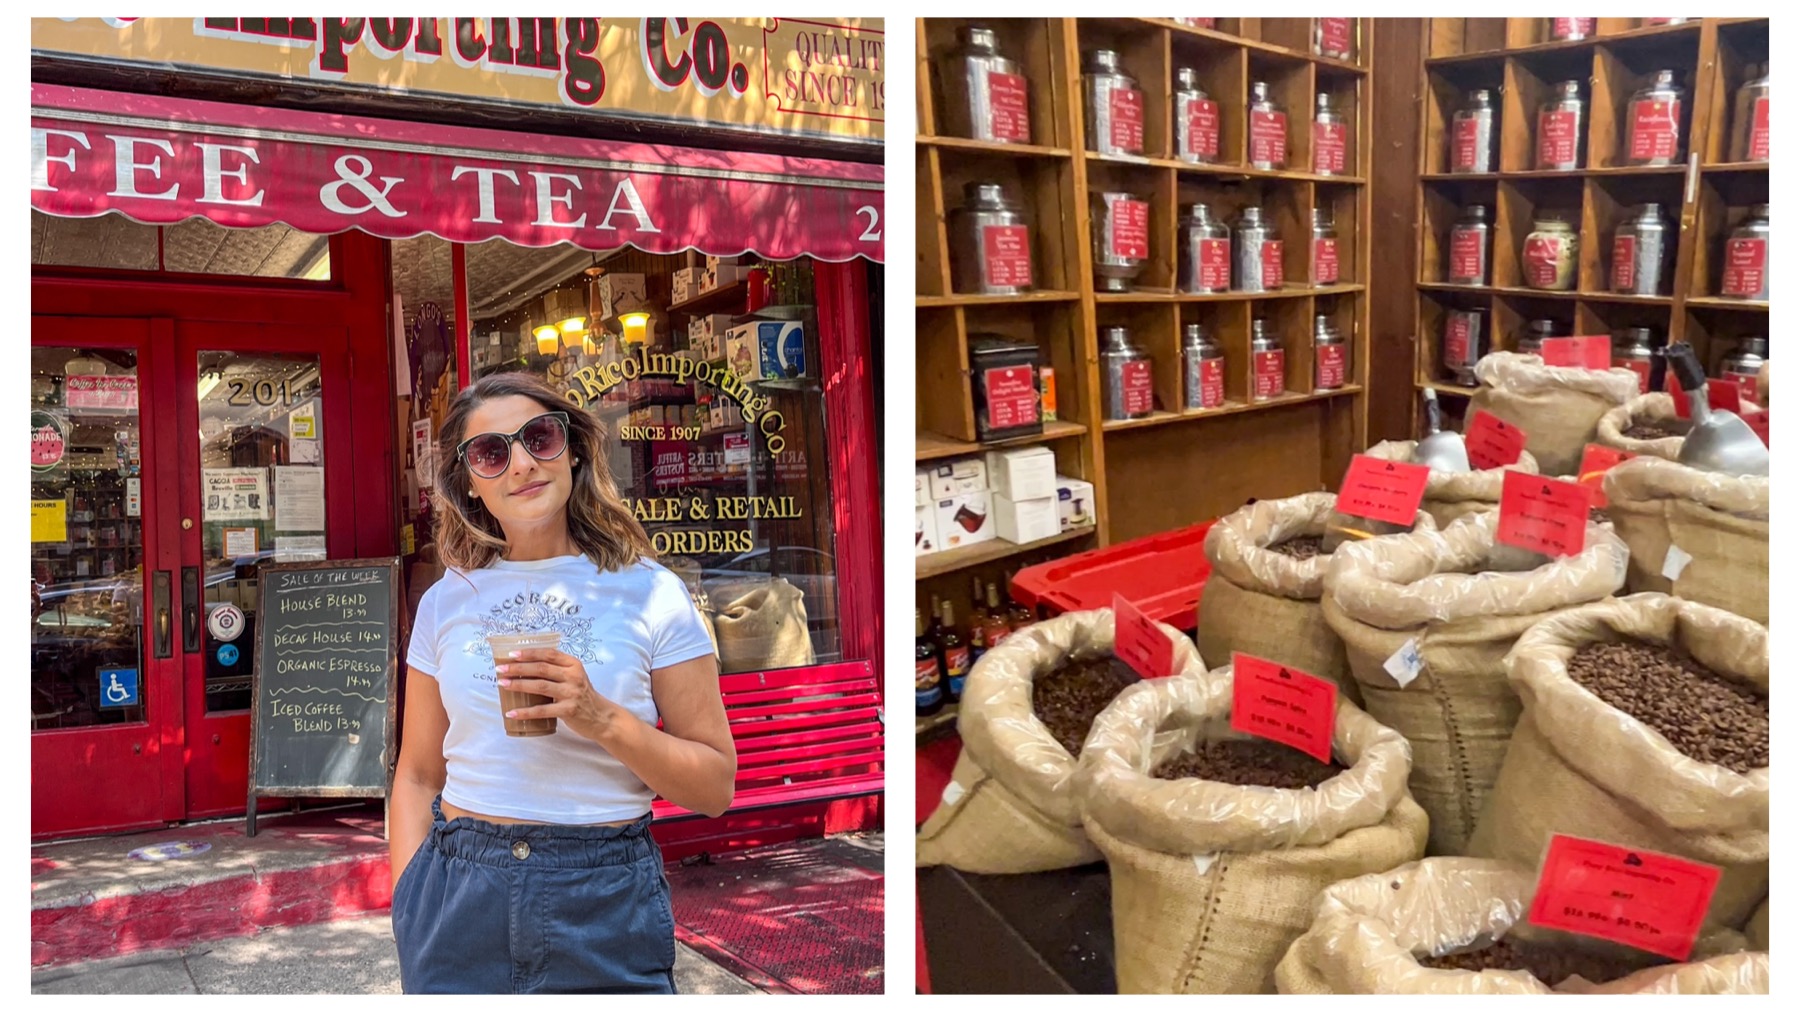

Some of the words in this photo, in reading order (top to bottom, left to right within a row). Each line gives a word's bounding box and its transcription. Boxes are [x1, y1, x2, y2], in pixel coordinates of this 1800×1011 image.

[646, 16, 749, 93] Co.
[795, 31, 884, 72] QUALIT
[785, 67, 857, 108] SINCE
[31, 128, 265, 207] FEE
[319, 154, 408, 218] &
[451, 165, 662, 232] TEA
[855, 205, 882, 241] 2
[229, 378, 293, 407] 201
[573, 357, 639, 400] Rico
[639, 344, 768, 426] Importing
[759, 409, 787, 459] Co.
[31, 432, 62, 442] ONADE
[621, 426, 666, 442] SINCE
[669, 425, 702, 441] 1907
[689, 496, 711, 519] &
[715, 496, 803, 519] RETAIL
[651, 530, 753, 554] ORDERS
[281, 574, 308, 587] SALE
[314, 573, 323, 584] OF
[328, 572, 347, 582] THE
[352, 570, 380, 581] WEEK
[281, 597, 322, 613] HOUSE
[327, 594, 367, 607] BLEND
[490, 591, 582, 616] SCORPIO
[274, 632, 308, 647] DECAF
[313, 631, 352, 644] HOUSE
[277, 659, 326, 674] ORGANIC
[329, 659, 382, 673] ESPRESSO
[473, 672, 498, 683] CON
[270, 699, 300, 717] ICED
[305, 702, 344, 716] COFFEE
[293, 718, 332, 733] BLEND
